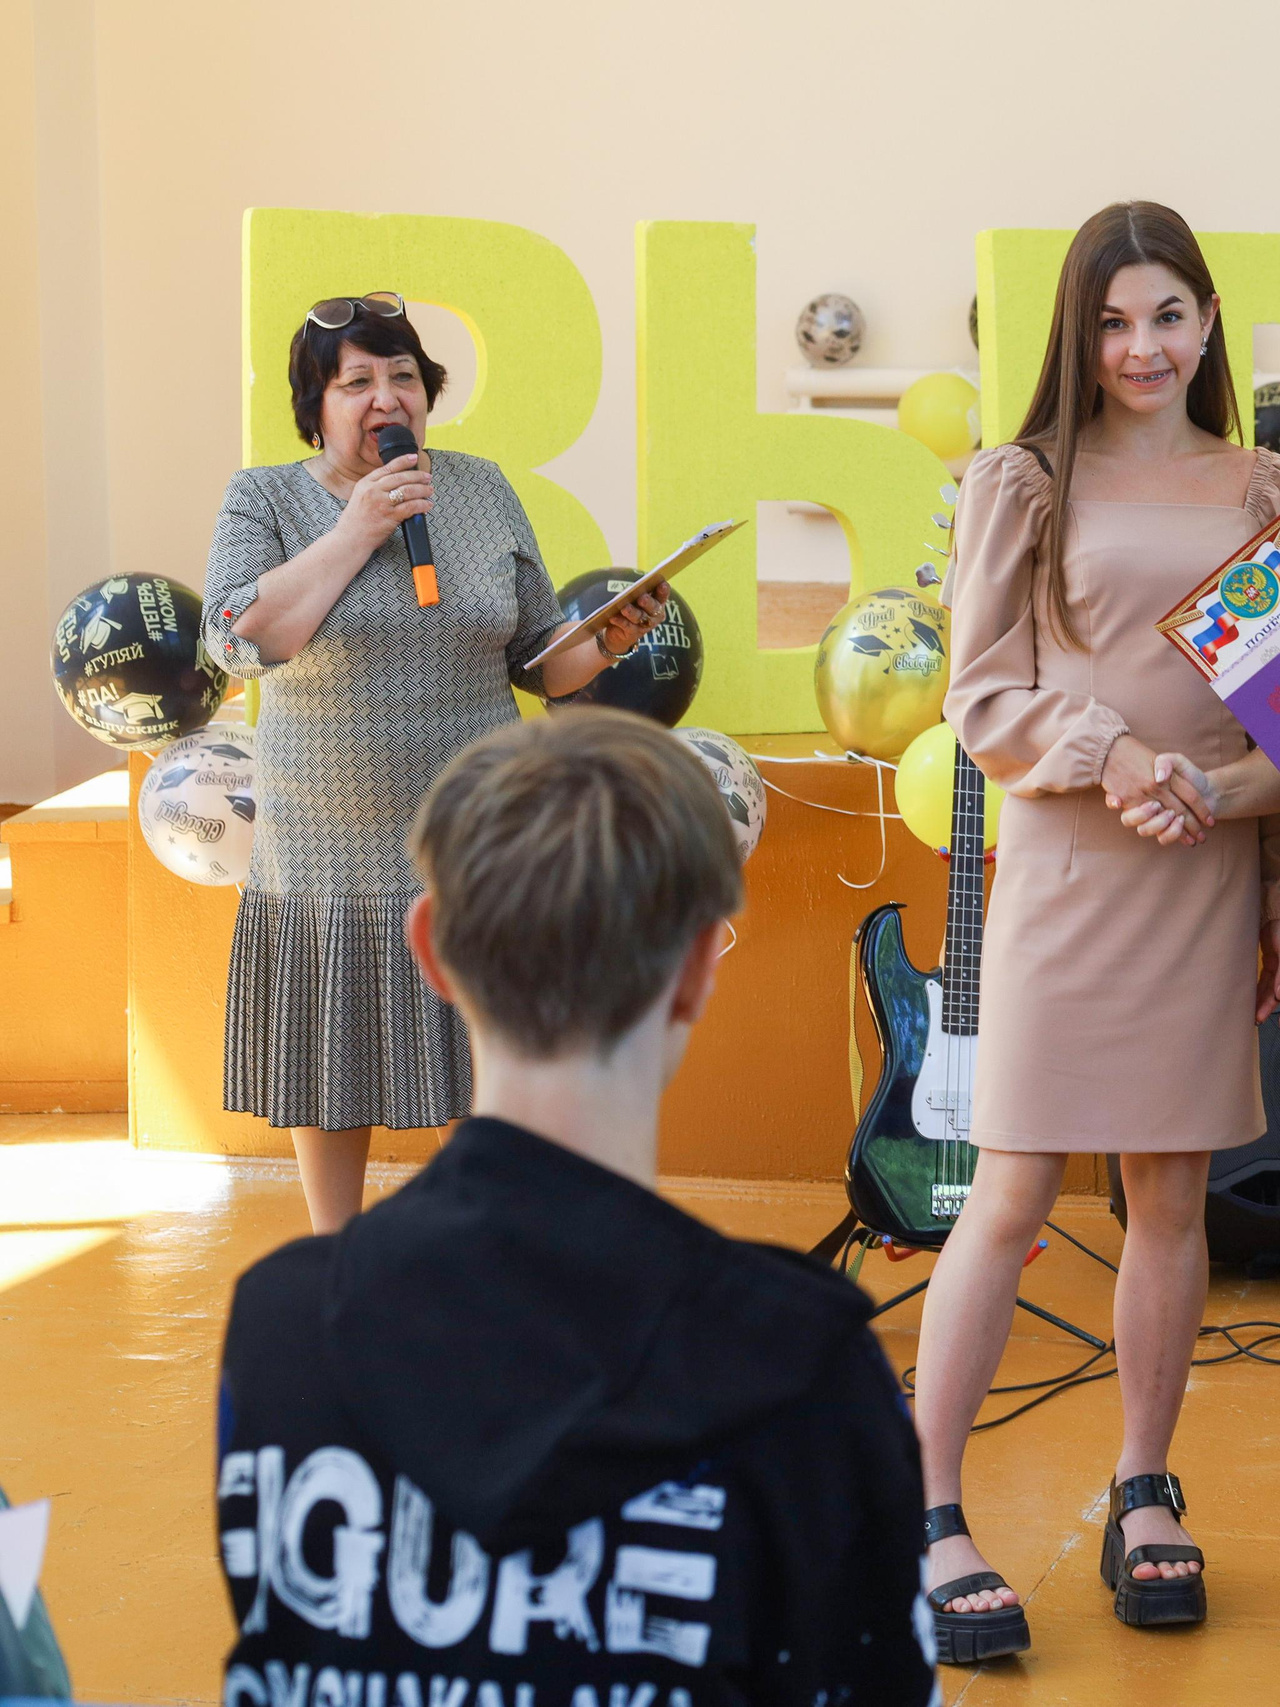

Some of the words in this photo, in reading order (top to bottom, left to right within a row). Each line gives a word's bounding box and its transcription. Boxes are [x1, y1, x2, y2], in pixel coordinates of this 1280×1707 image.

[136, 582, 163, 642] #ТЕПЕРЬ
[153, 578, 178, 632] МОЖНО
[858, 607, 895, 631] Ура!
[84, 641, 145, 678] #ГУЛЯЙ
[77, 682, 120, 709] #ДА!
